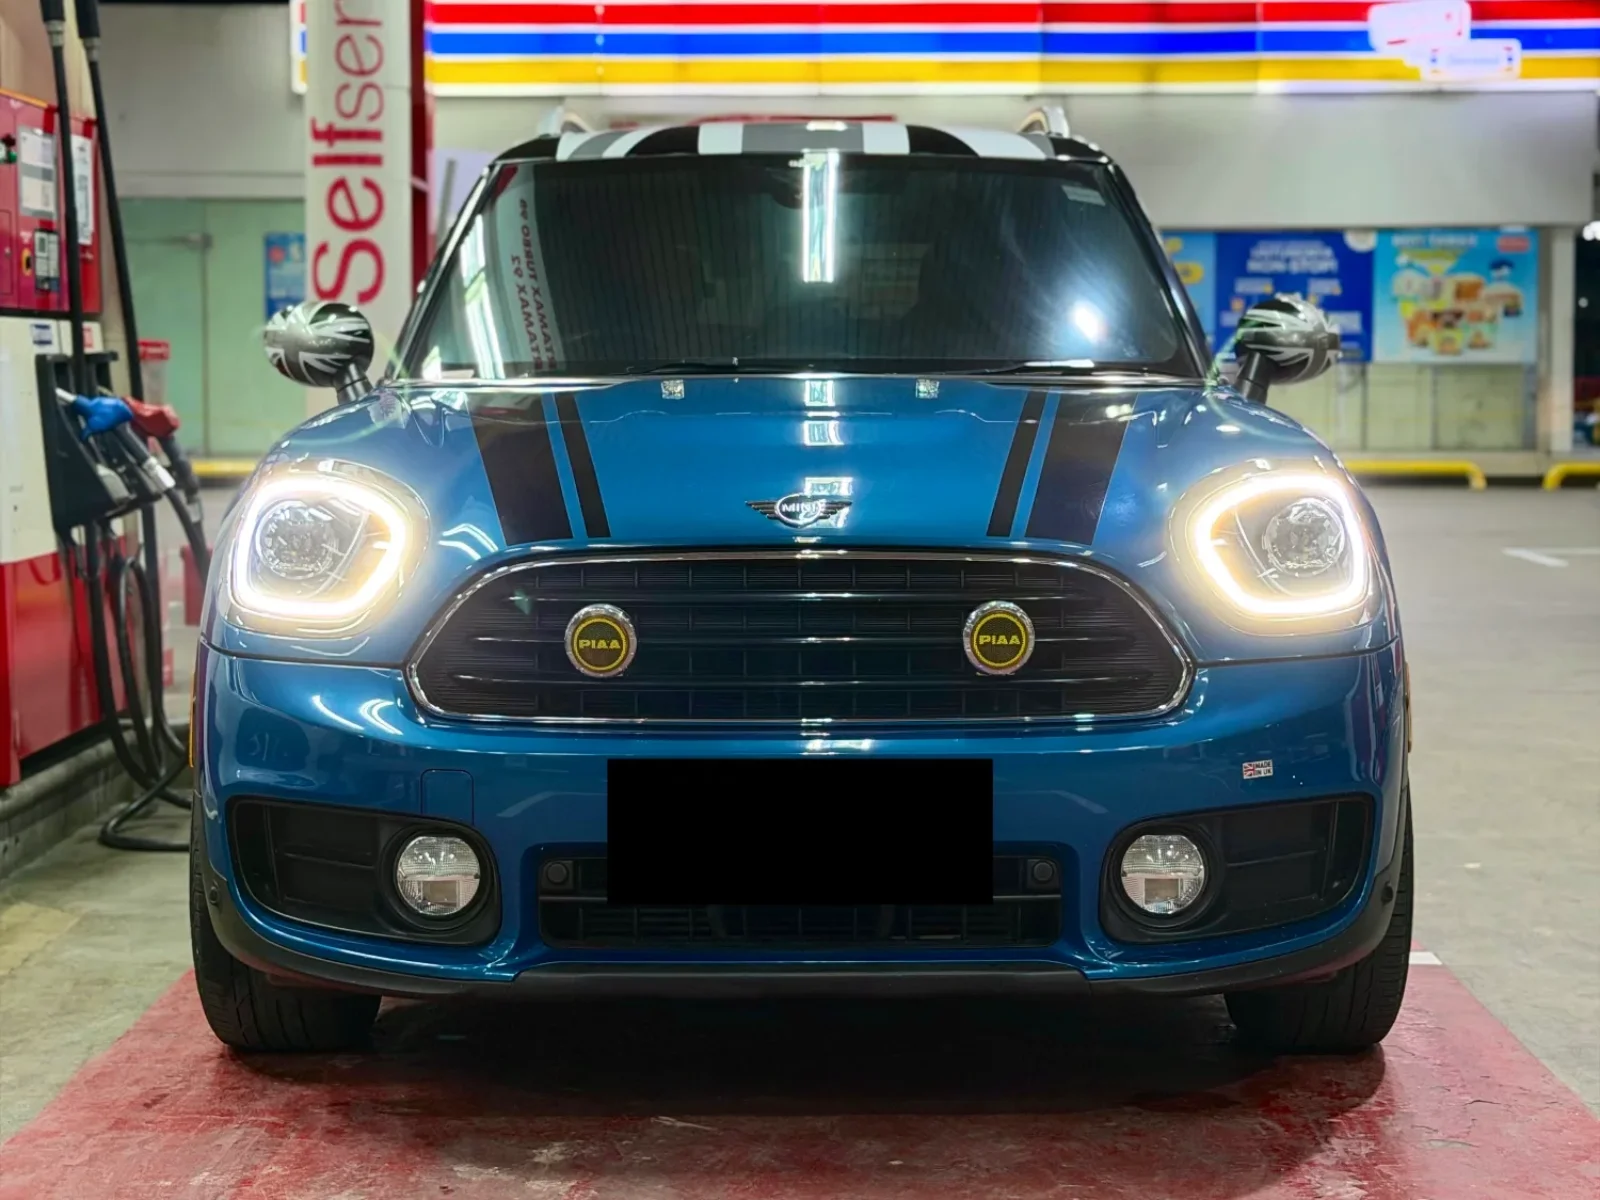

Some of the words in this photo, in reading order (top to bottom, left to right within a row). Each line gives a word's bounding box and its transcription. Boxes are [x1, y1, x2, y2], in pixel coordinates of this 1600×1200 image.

[781, 503, 816, 512] MINI
[578, 639, 621, 649] PIAA
[978, 635, 1020, 645] PIAA
[1255, 761, 1271, 769] MADE
